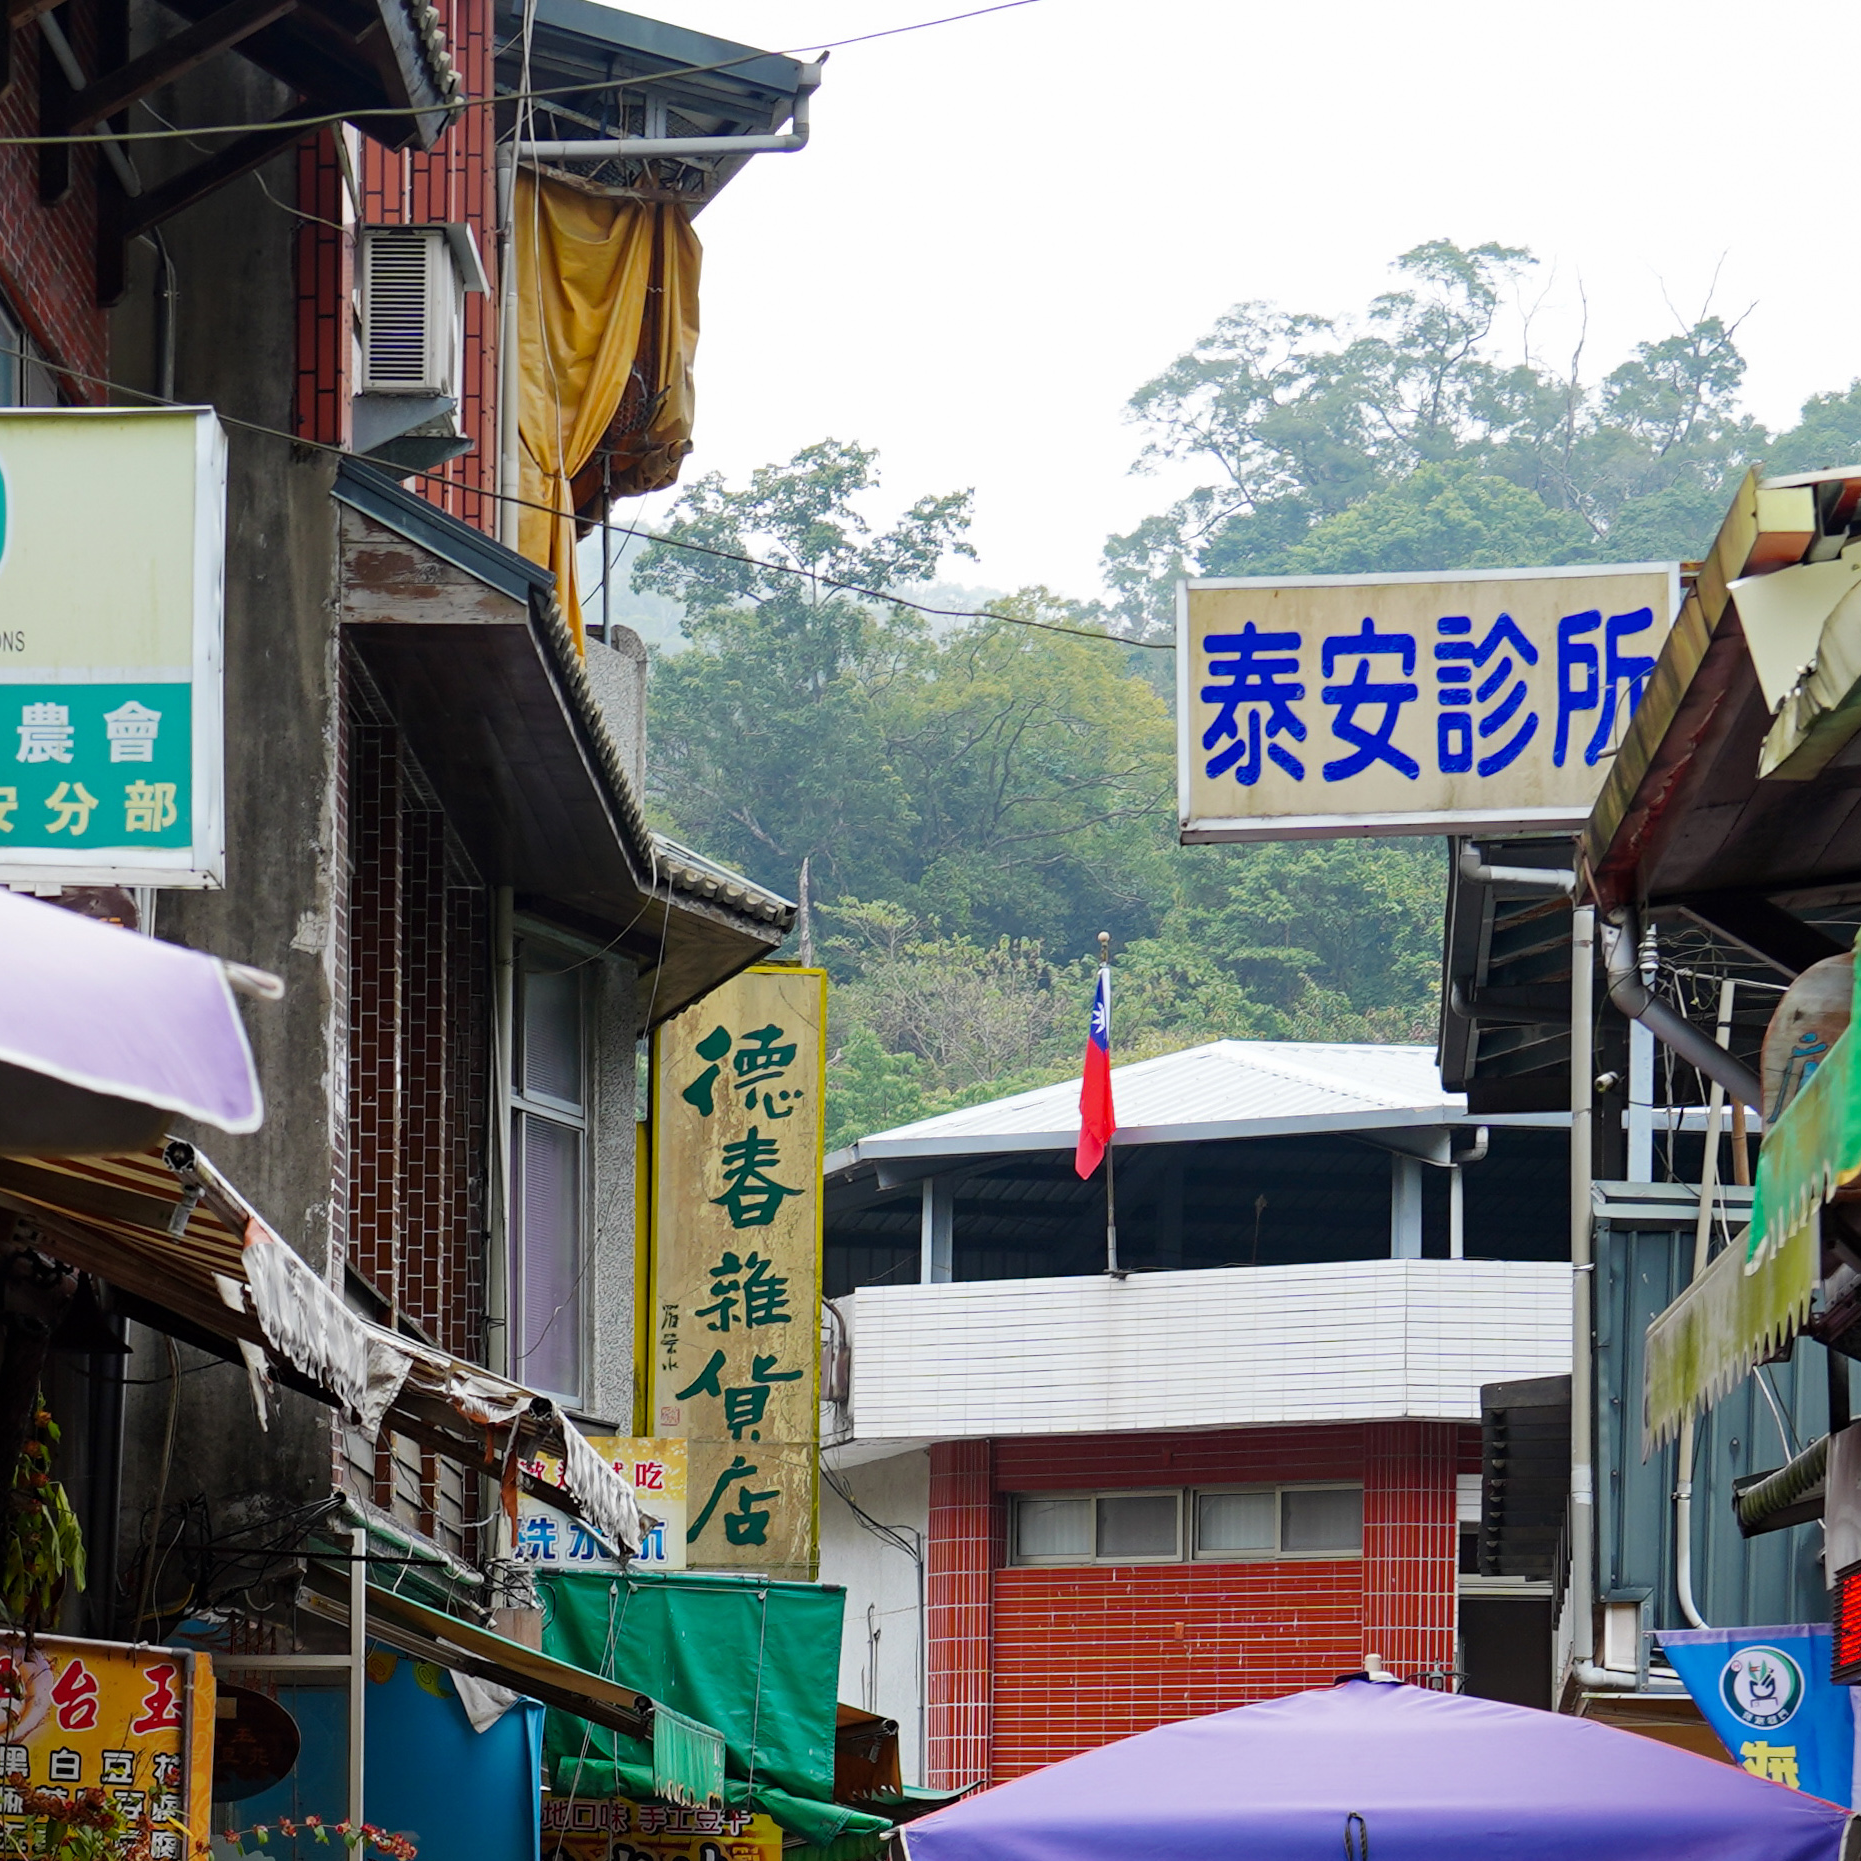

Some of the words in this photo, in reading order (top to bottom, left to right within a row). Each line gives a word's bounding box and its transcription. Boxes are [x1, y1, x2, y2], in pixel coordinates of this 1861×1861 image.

[1200, 606, 1656, 786] 泰安診所
[675, 1022, 805, 1547] 德春雜貨店
